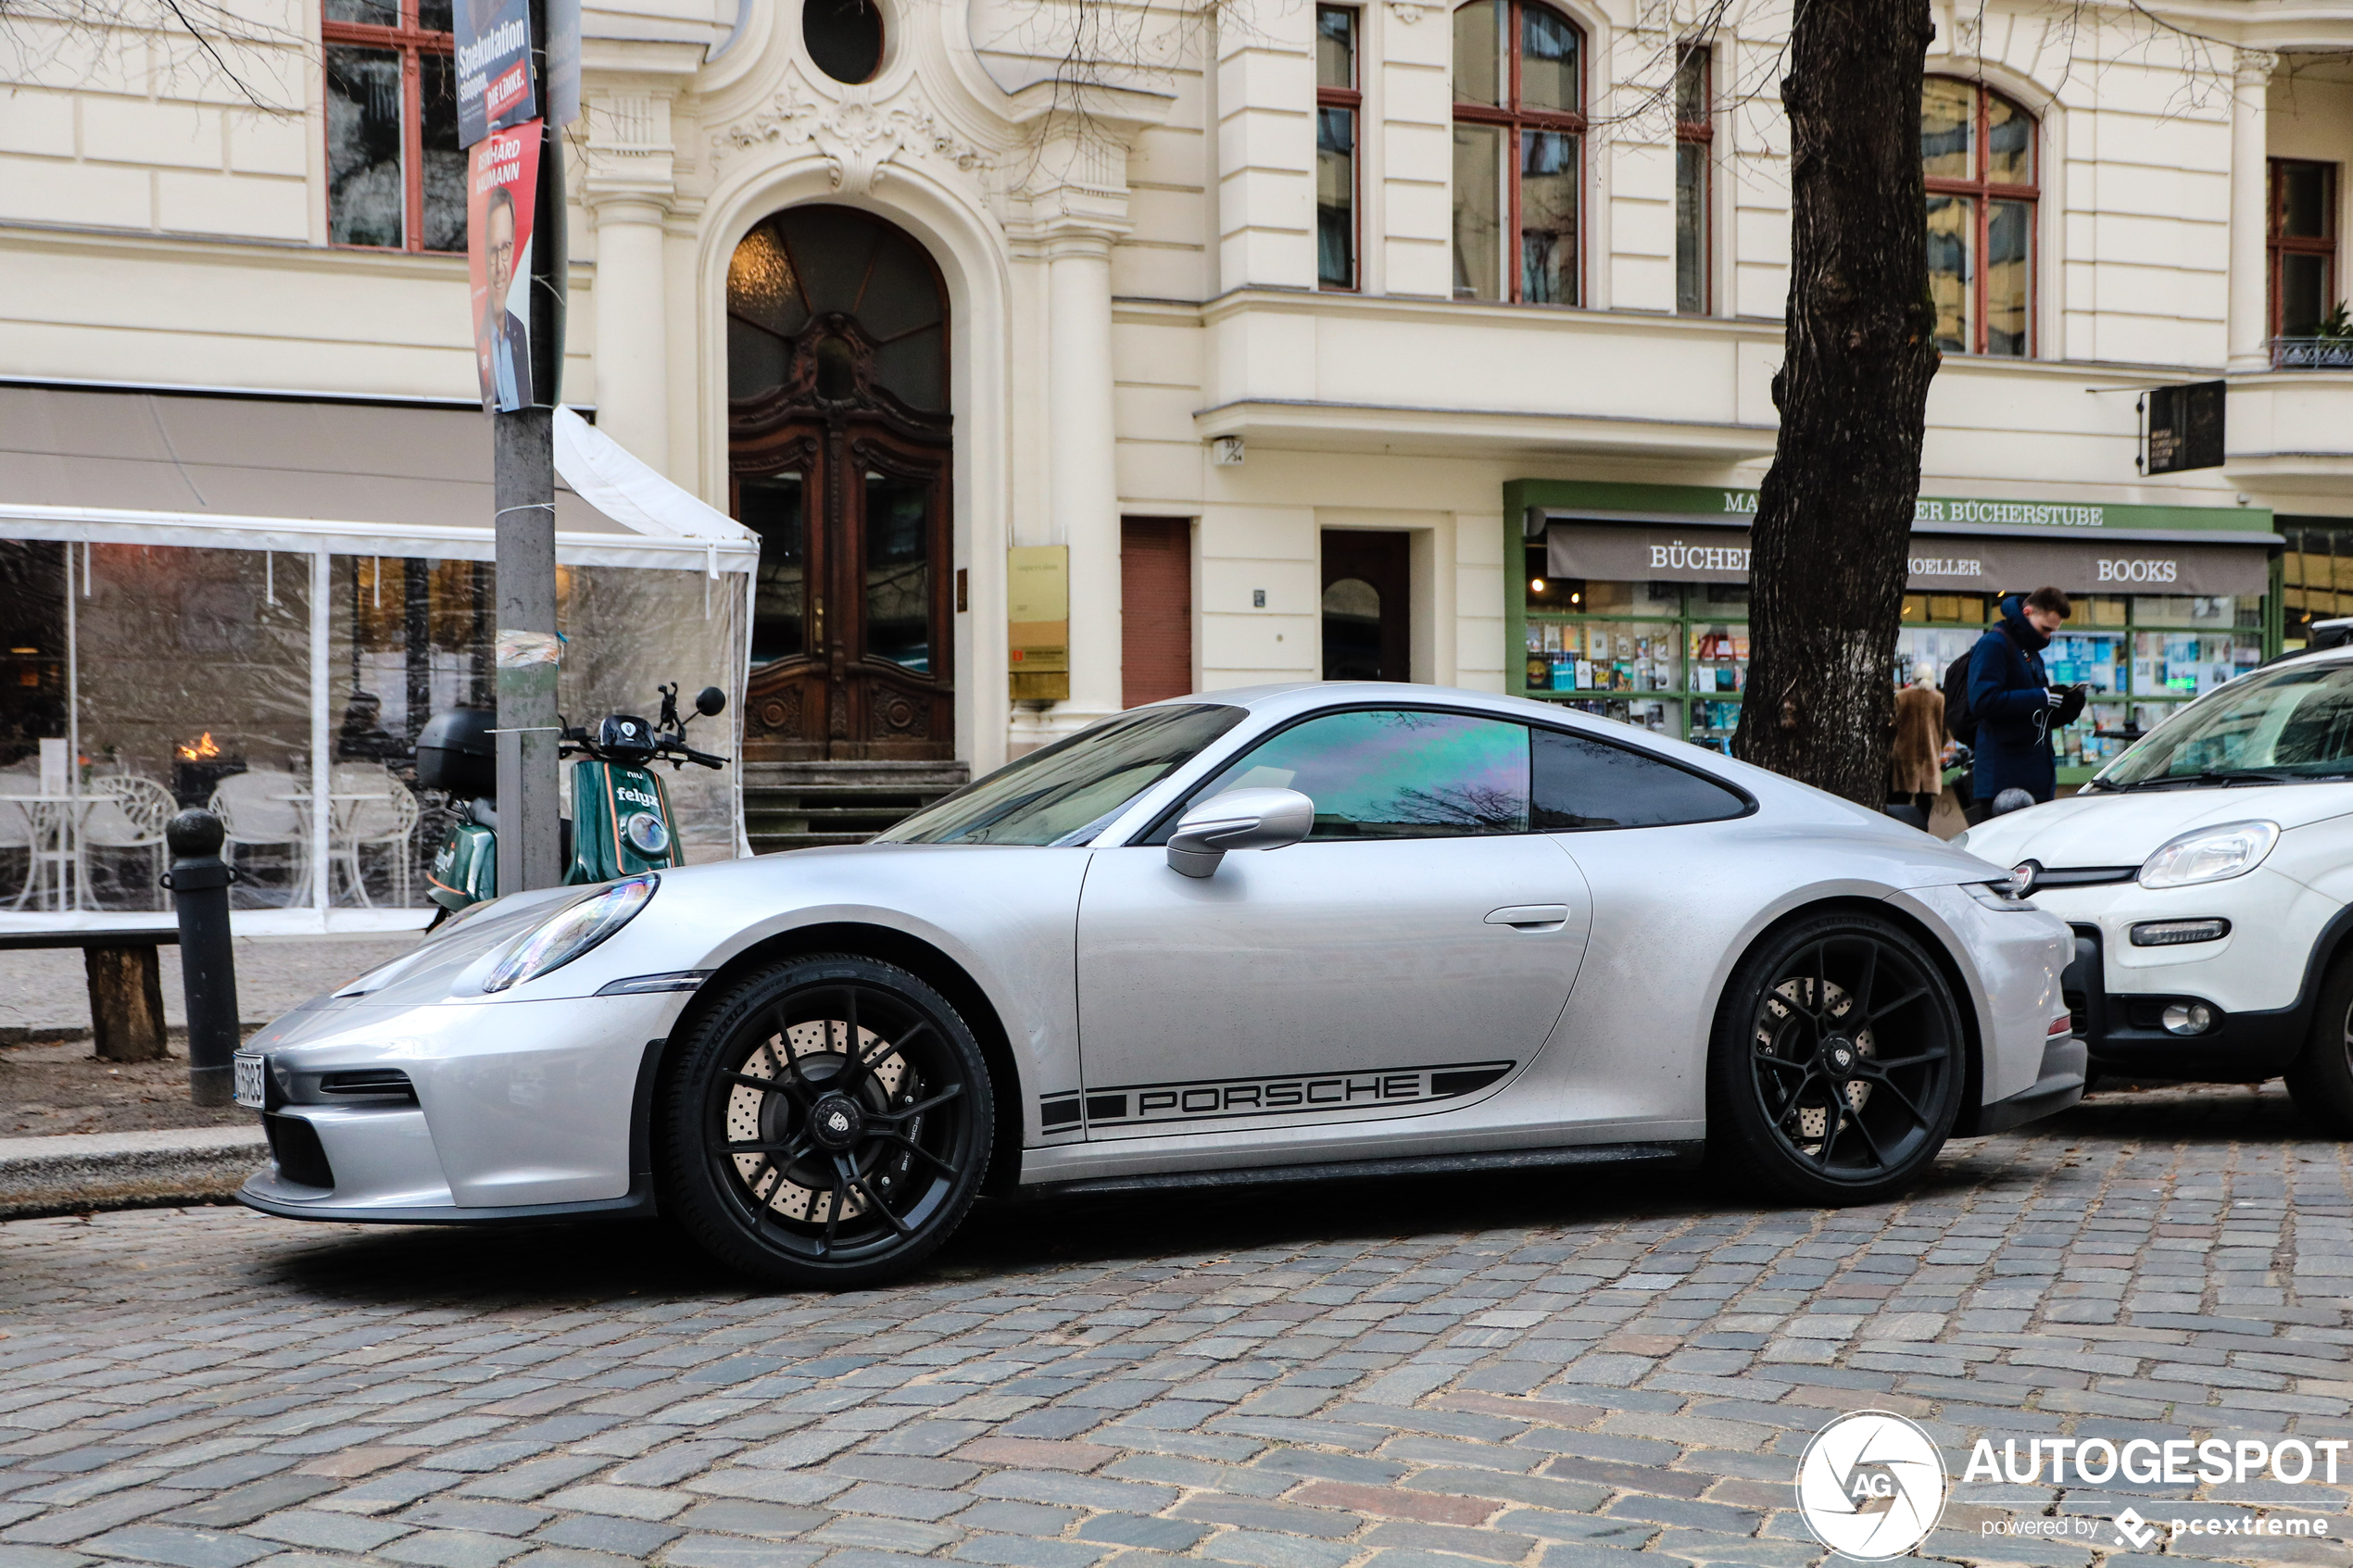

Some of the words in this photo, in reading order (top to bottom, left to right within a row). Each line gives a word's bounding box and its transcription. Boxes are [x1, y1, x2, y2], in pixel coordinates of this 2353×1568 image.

[459, 19, 524, 78] Spekulation
[487, 85, 500, 111] DIE
[478, 139, 521, 172] REINHARD
[476, 161, 521, 196] NAUMANN
[1724, 492, 1758, 513] MA
[1915, 500, 1944, 521] ER
[1949, 499, 2103, 527] BÜCHERSTUBE
[2097, 558, 2177, 583] BOOKS
[616, 786, 660, 808] felyx
[699, 1004, 746, 1068] MICHELIN
[1139, 1073, 1420, 1116] PORSCHE
[900, 1116, 921, 1172] PORHE
